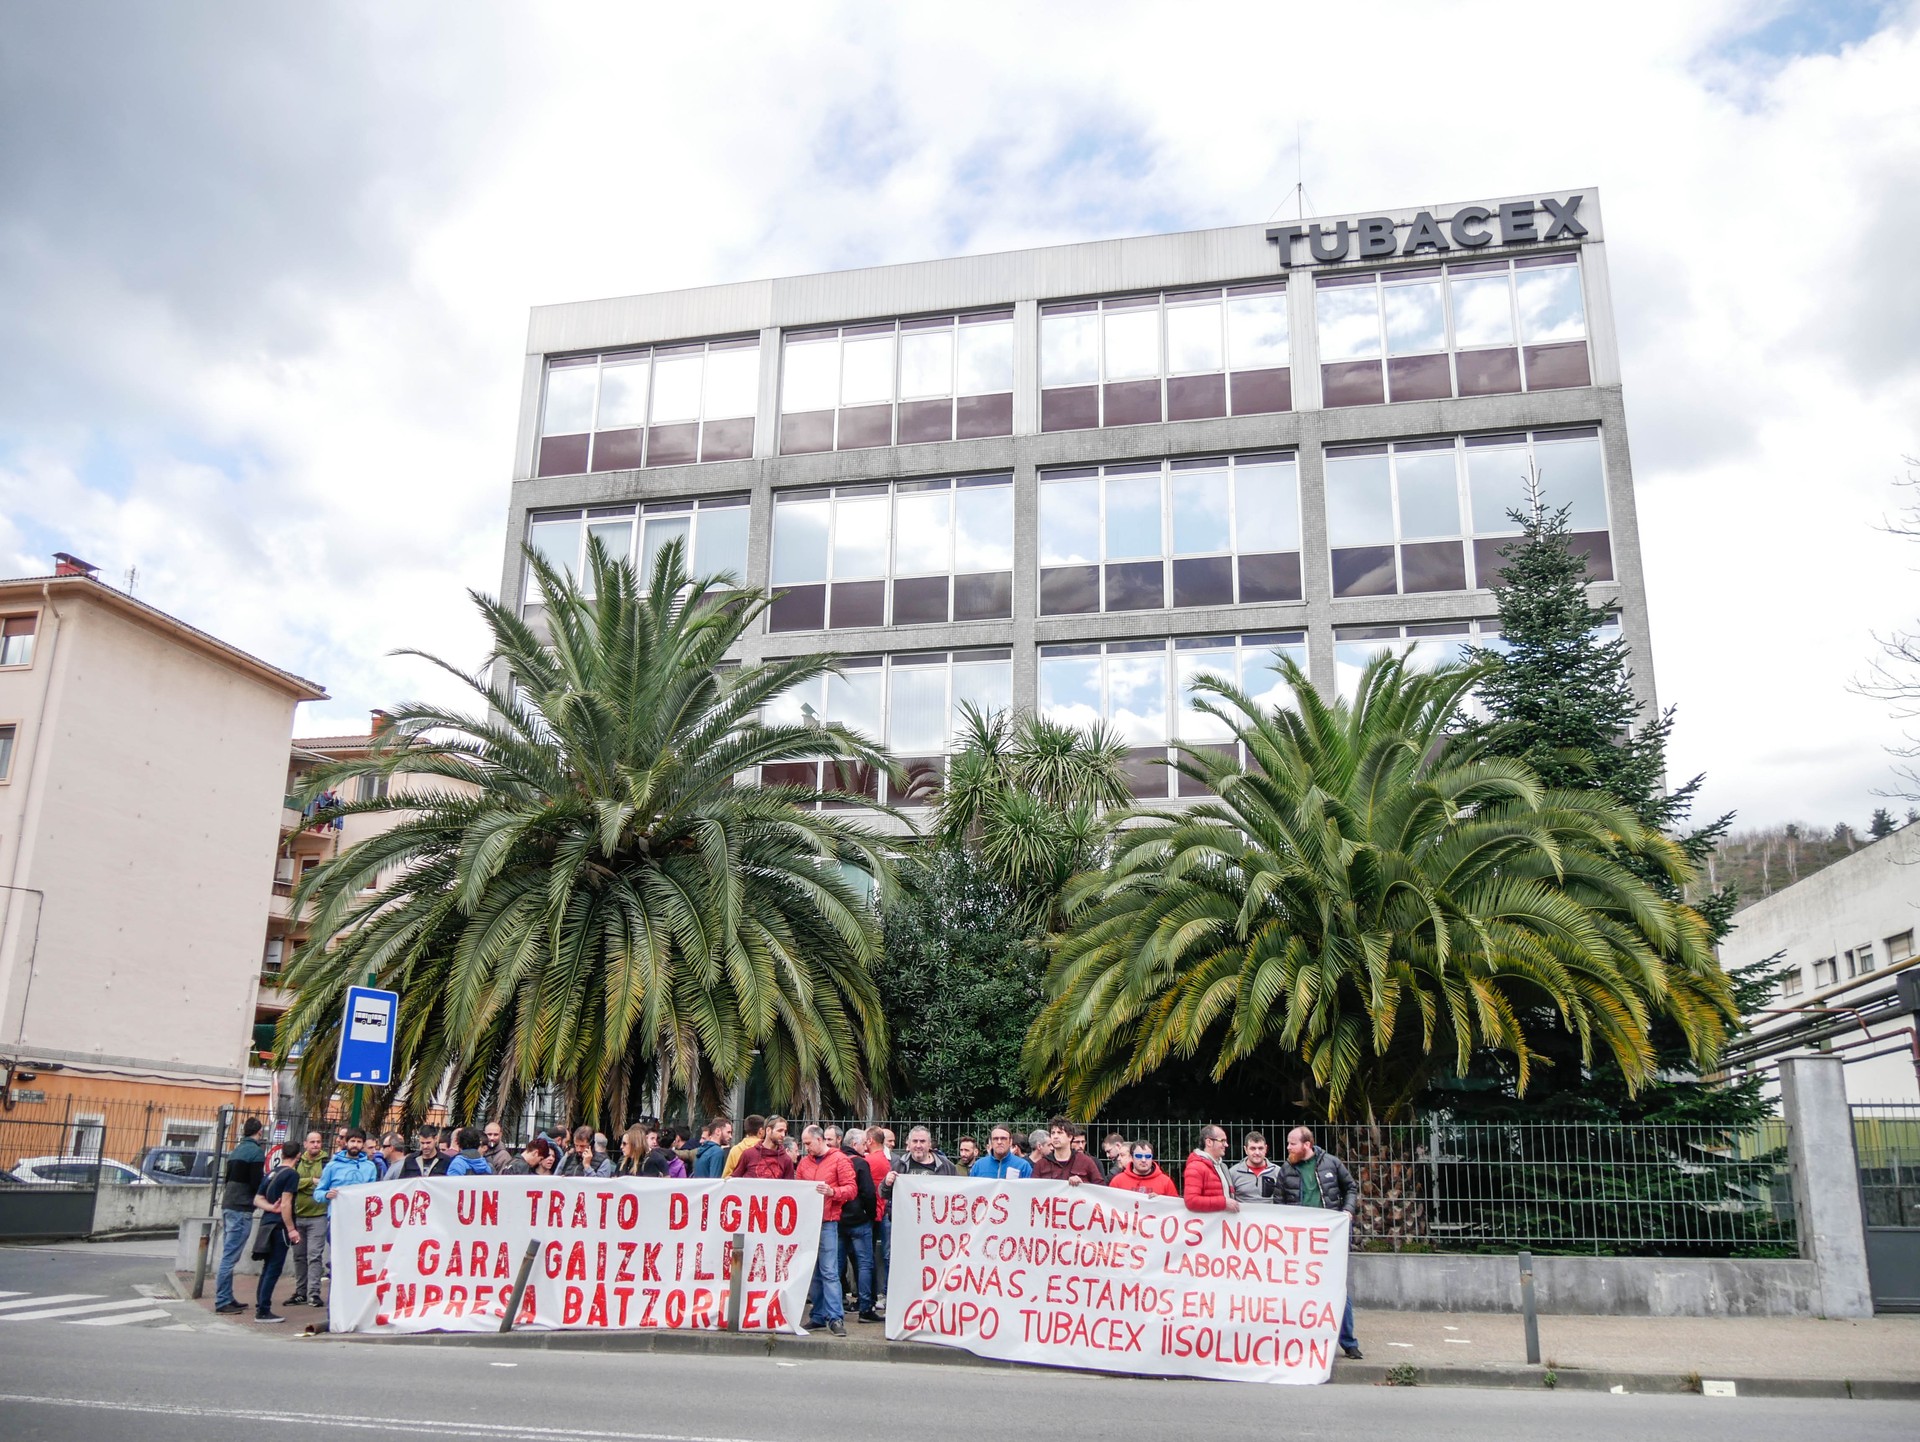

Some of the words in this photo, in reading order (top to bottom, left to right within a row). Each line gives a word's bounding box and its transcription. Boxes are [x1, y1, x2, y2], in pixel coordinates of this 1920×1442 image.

[1266, 195, 1588, 268] TUBACEX
[365, 1190, 431, 1232] POR
[457, 1189, 499, 1226] UN
[526, 1190, 639, 1230] TRATO
[668, 1192, 797, 1236] DIGNO
[910, 1193, 1010, 1226] TUBOS
[1030, 1196, 1204, 1247] MECANICOS
[1221, 1219, 1330, 1256] NORTE
[417, 1239, 510, 1279] GARA
[920, 1233, 971, 1260] POR
[982, 1233, 1148, 1270] CONDICIONES
[1163, 1251, 1324, 1286] LABORALES
[903, 1299, 999, 1340] GRUPO
[1019, 1309, 1146, 1353] TUBACEX
[1046, 1275, 1175, 1315] ESTAMOS
[1182, 1291, 1215, 1319] EN
[1229, 1294, 1337, 1331] HUELGA
